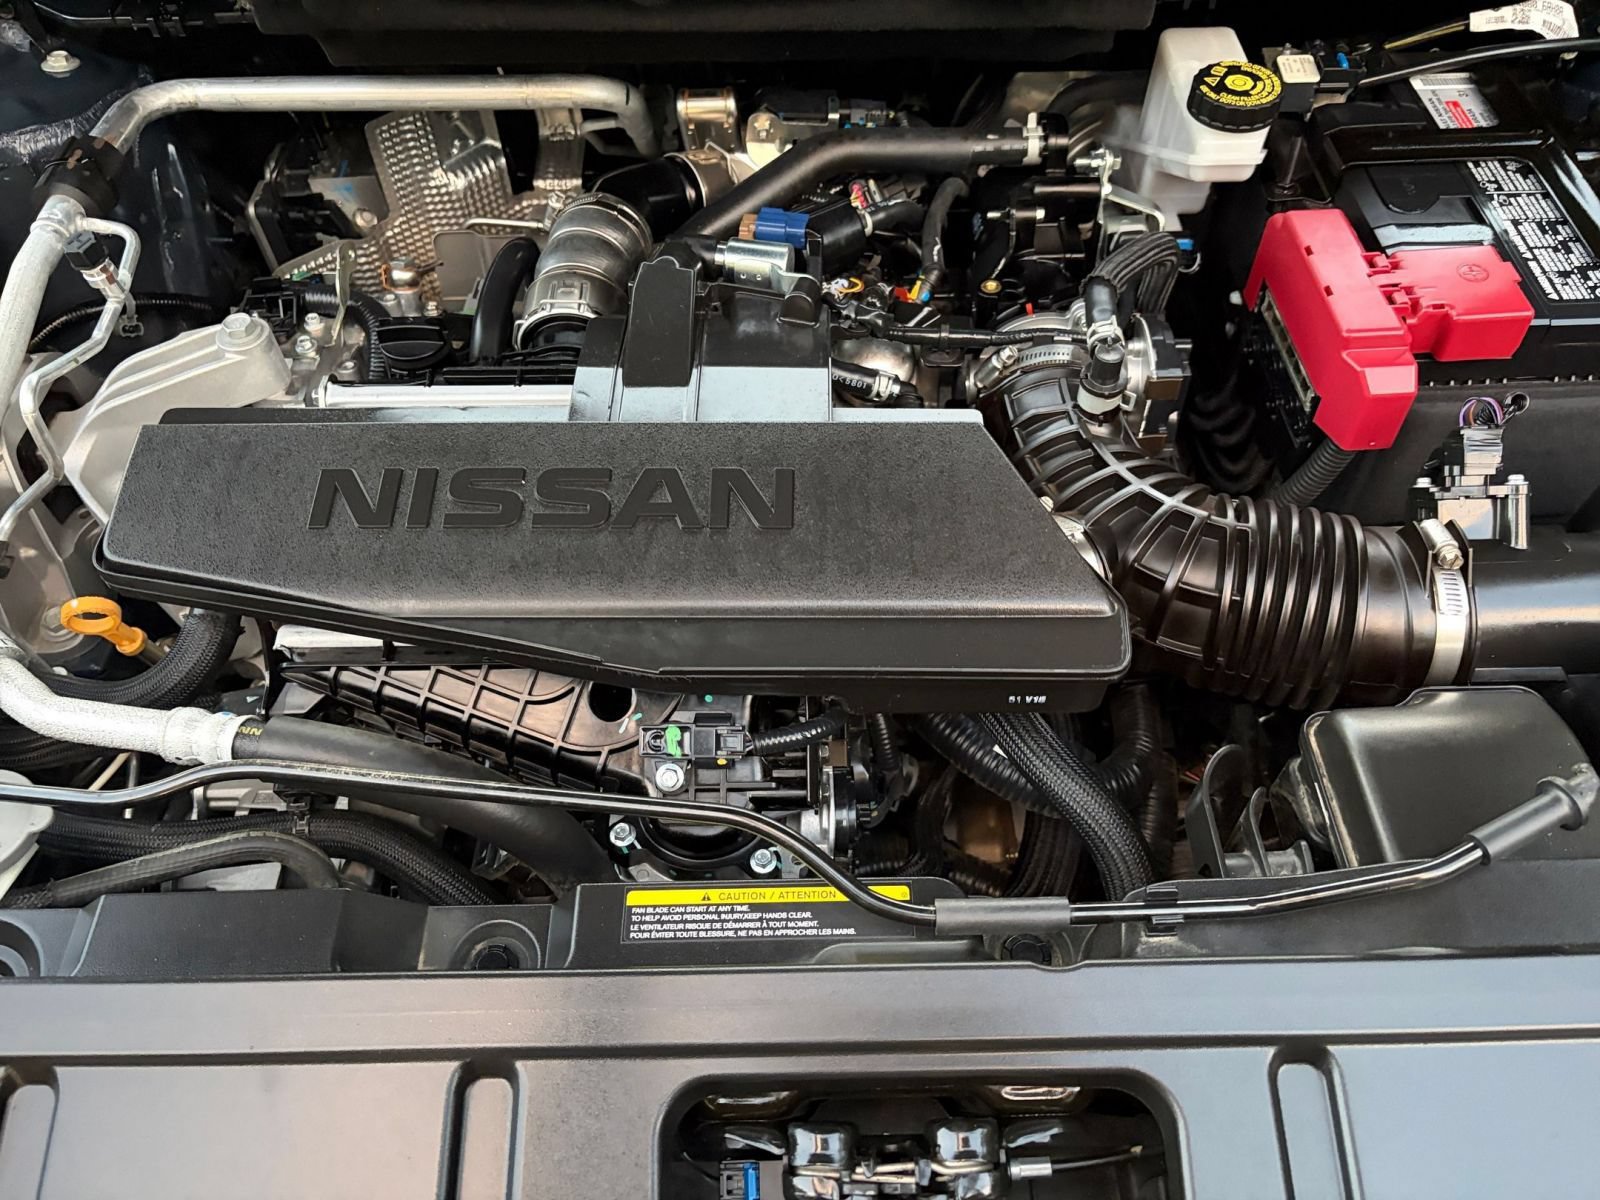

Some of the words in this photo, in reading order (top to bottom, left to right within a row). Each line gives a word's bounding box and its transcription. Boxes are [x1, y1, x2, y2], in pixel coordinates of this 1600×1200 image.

[307, 467, 796, 531] NISSAN
[718, 892, 766, 901] CAUTION
[778, 890, 837, 900] ATTENTION
[631, 906, 646, 914] FAN
[733, 904, 751, 912] TIME.
[641, 914, 660, 922] HELP
[683, 913, 720, 921] PERSONAL
[788, 911, 813, 919] CLEAR.
[640, 923, 685, 931] VENTILATEUR
[685, 922, 711, 930] RISQUE
[712, 922, 723, 930] DE
[723, 920, 761, 930] DÉMARRER
[762, 920, 768, 928] À
[768, 920, 787, 928] TOUT
[787, 919, 820, 928] MOMENT.
[629, 931, 651, 939] POUR
[651, 929, 675, 938] ÉVITER
[675, 930, 699, 938] TOUTE
[699, 929, 737, 938] BLESSURE,
[738, 929, 748, 937] NE
[748, 929, 763, 937] PAS
[774, 928, 818, 937] APPROCHER
[818, 927, 832, 935] LES
[832, 927, 857, 936] MAINS.
